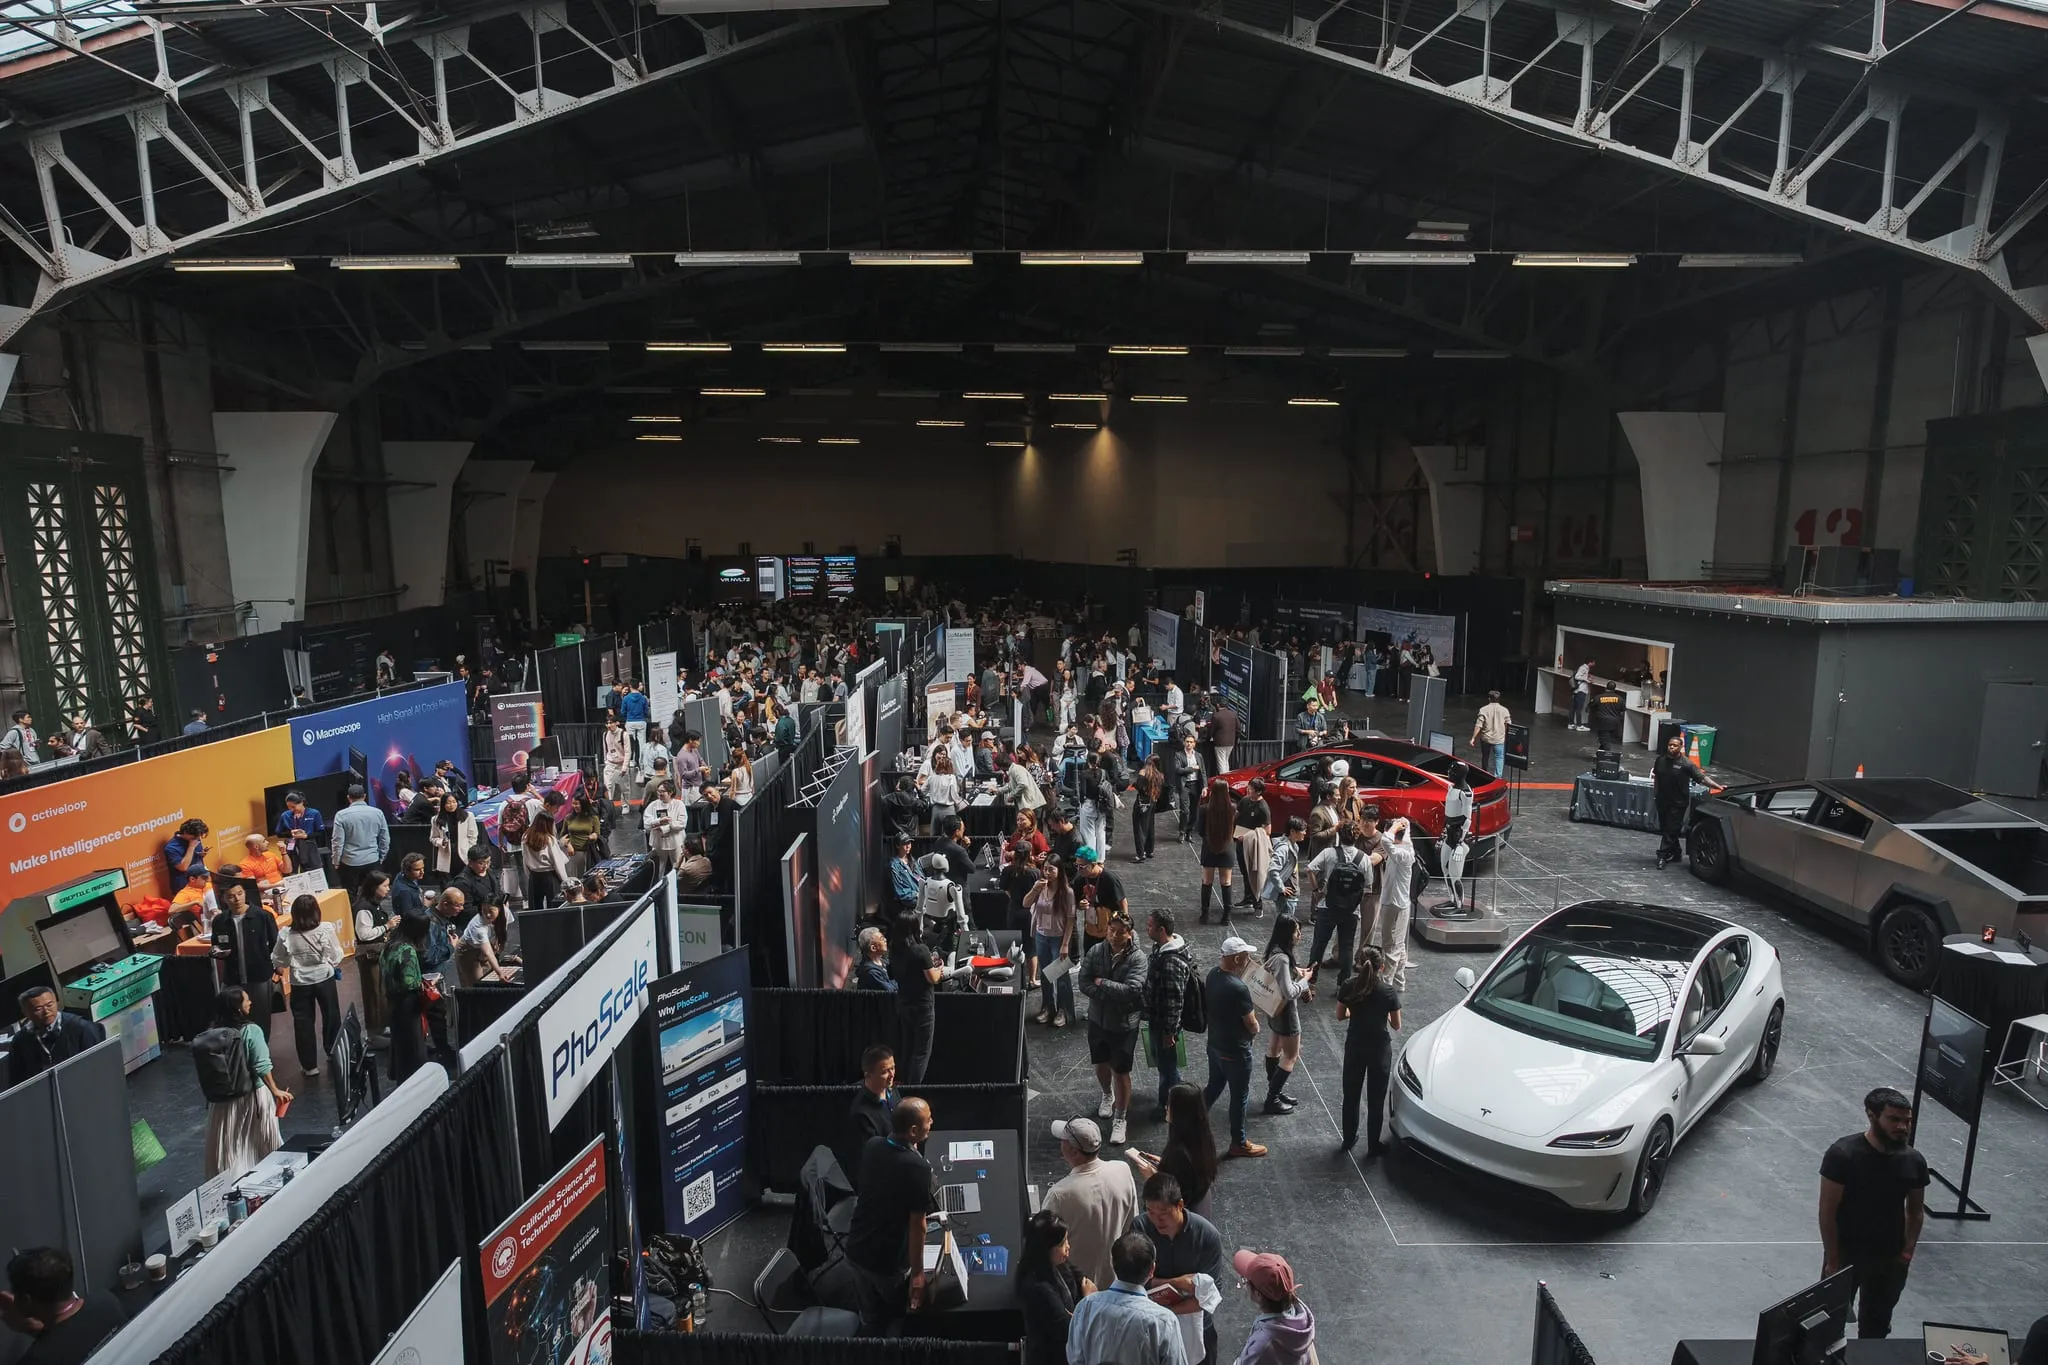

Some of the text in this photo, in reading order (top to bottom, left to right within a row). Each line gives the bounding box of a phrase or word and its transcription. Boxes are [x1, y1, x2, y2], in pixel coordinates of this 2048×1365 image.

[377, 711, 393, 724] High
[316, 721, 361, 740] Macroscope
[500, 732, 516, 741] ship
[1583, 787, 1614, 796] TESLA
[32, 800, 87, 822] activeloop
[1617, 808, 1649, 817] TESLA
[10, 808, 184, 874] Make Intelligence Compound
[658, 1004, 676, 1018] Why
[676, 991, 709, 1011] PhoScale
[552, 959, 648, 1100] PhoScale
[520, 1158, 597, 1236] California Science and
[521, 1173, 596, 1249] Technology University
